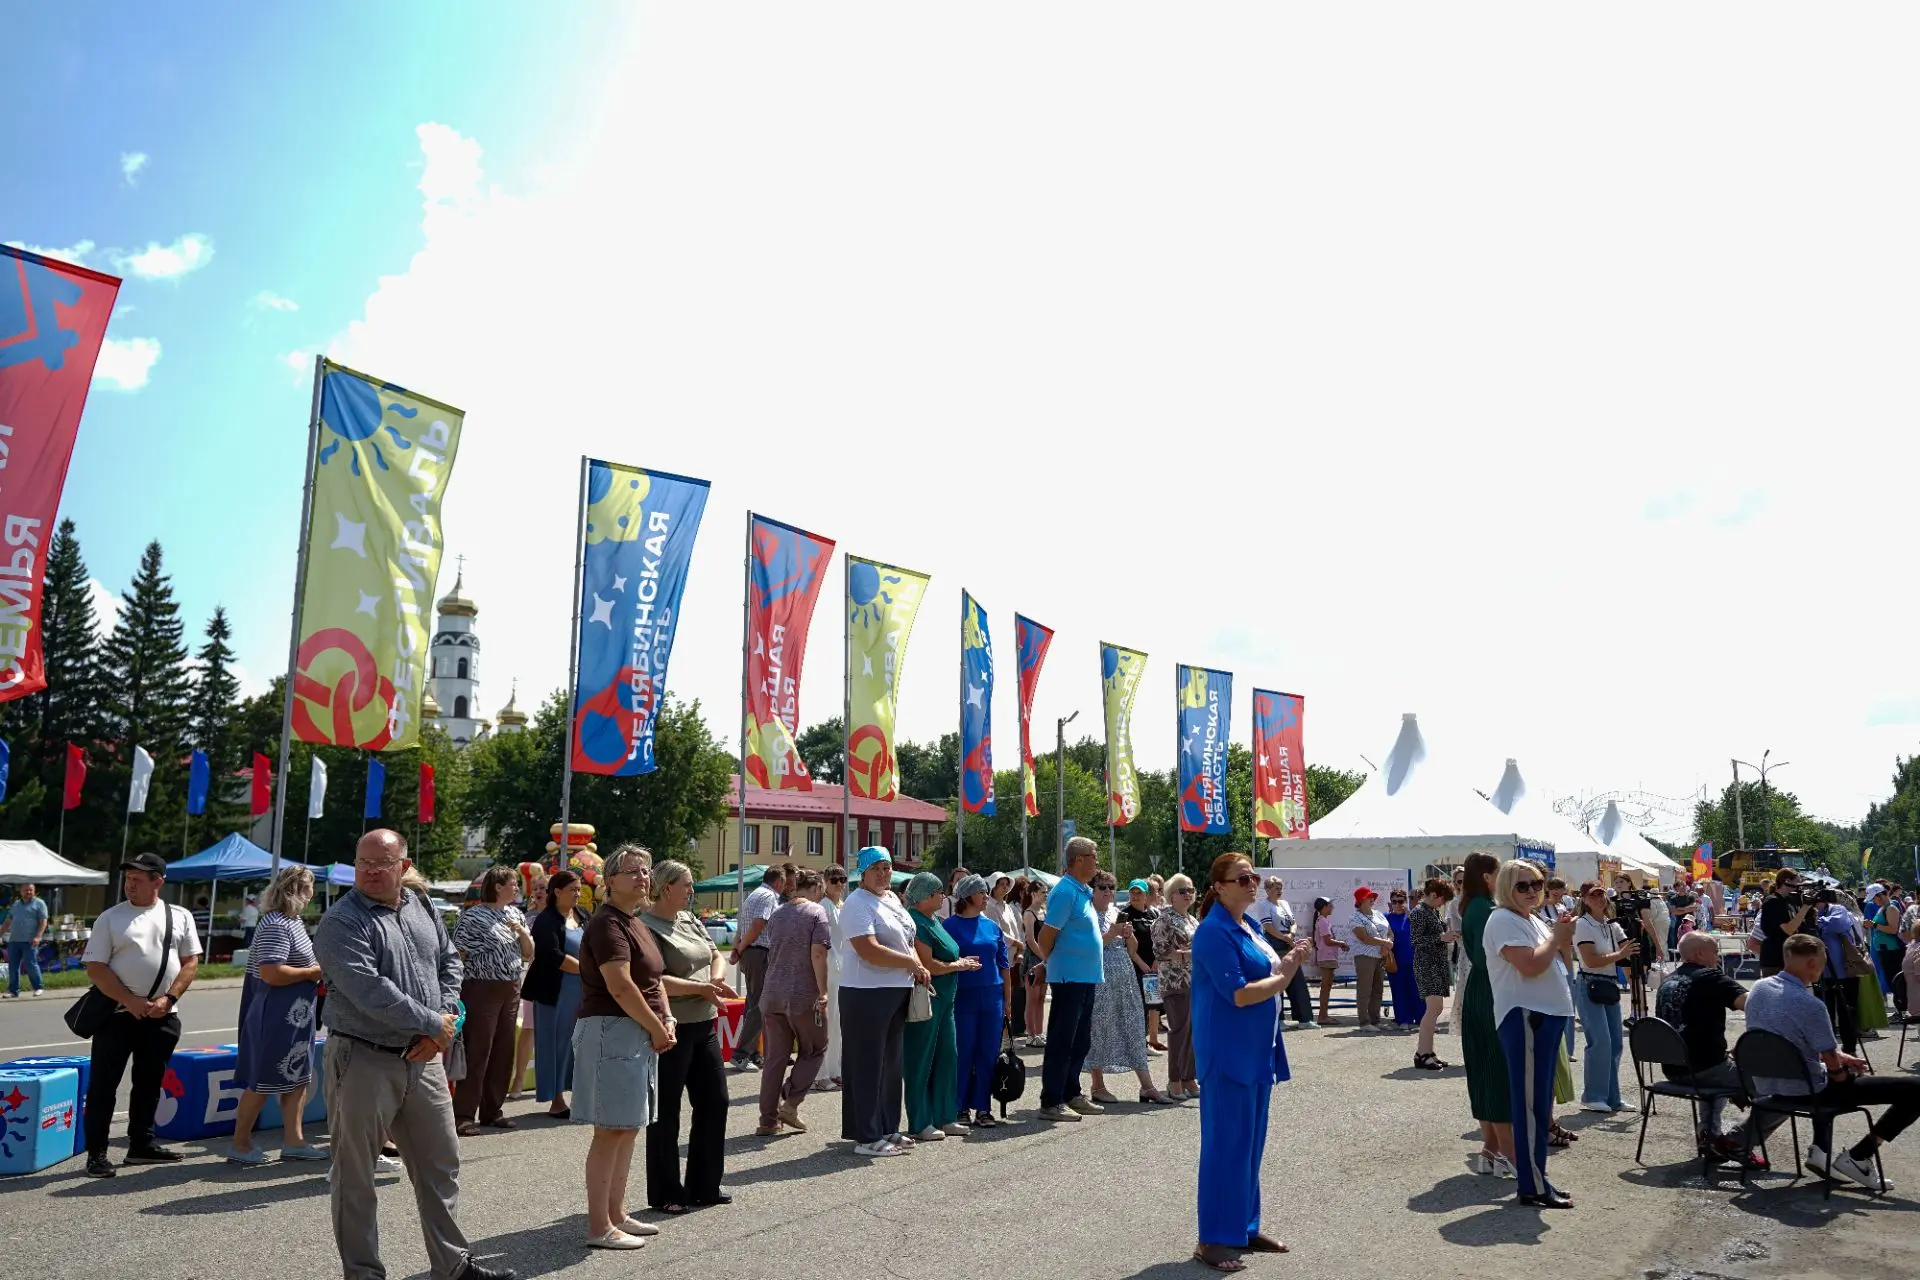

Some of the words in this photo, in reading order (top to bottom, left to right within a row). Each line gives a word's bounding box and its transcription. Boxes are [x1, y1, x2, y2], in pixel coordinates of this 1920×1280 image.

[388, 420, 450, 740] ФЕСТИВАЛЬ
[628, 511, 670, 761] ЧЕЛЯБИНСКАЯ
[768, 624, 790, 776] БОЬШАЯ
[780, 677, 807, 777] СМЬЯ
[1202, 690, 1218, 825] ЧЕЛЯБИНСКАЯ
[1212, 742, 1225, 825] ОБЛАСТЬ
[1292, 774, 1305, 831] СЕМЬЯ
